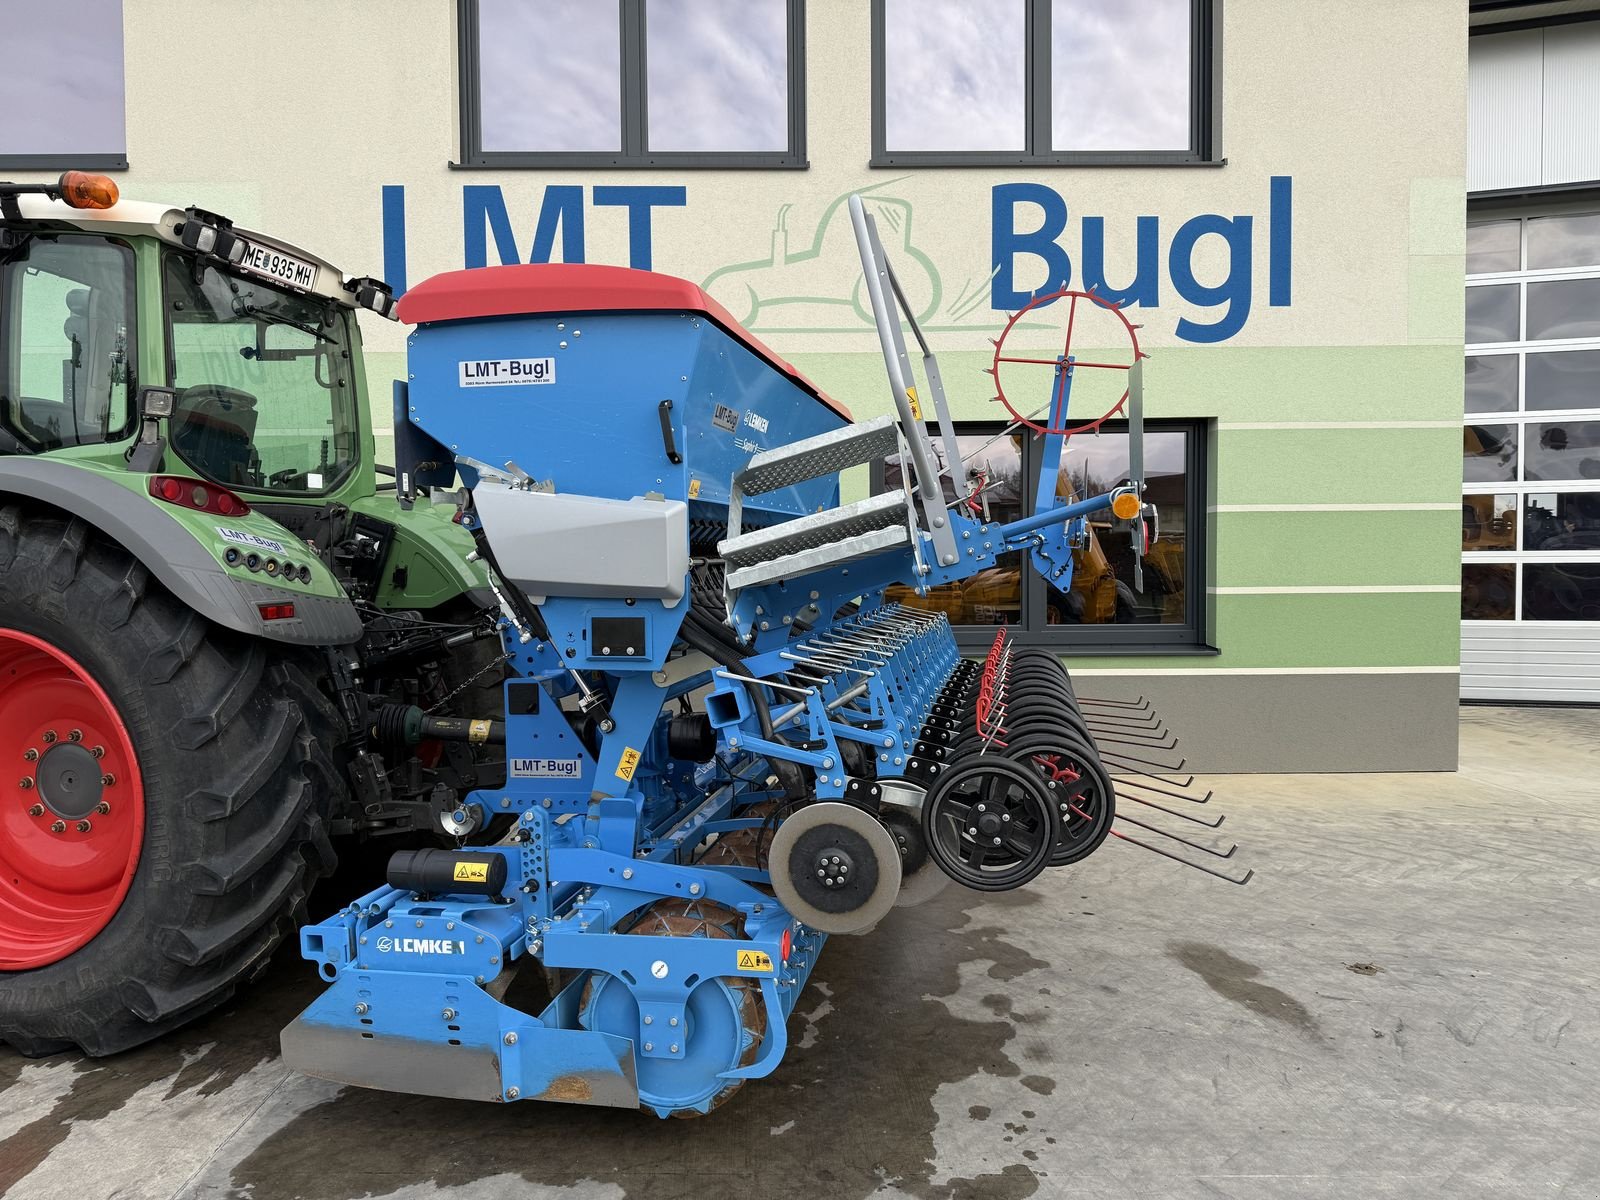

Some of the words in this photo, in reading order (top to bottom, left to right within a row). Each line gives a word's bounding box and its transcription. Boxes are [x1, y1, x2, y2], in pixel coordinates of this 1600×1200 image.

[244, 245, 264, 269] ME
[271, 256, 295, 279] 935
[294, 264, 312, 287] MH
[991, 176, 1292, 343] Bugl
[464, 359, 549, 379] LMT-Bugl
[714, 403, 740, 429] LMT-Bugl
[748, 412, 770, 434] LEMKEN
[220, 527, 283, 552] LMT-Bugl
[514, 759, 577, 774] LMT-Bugl
